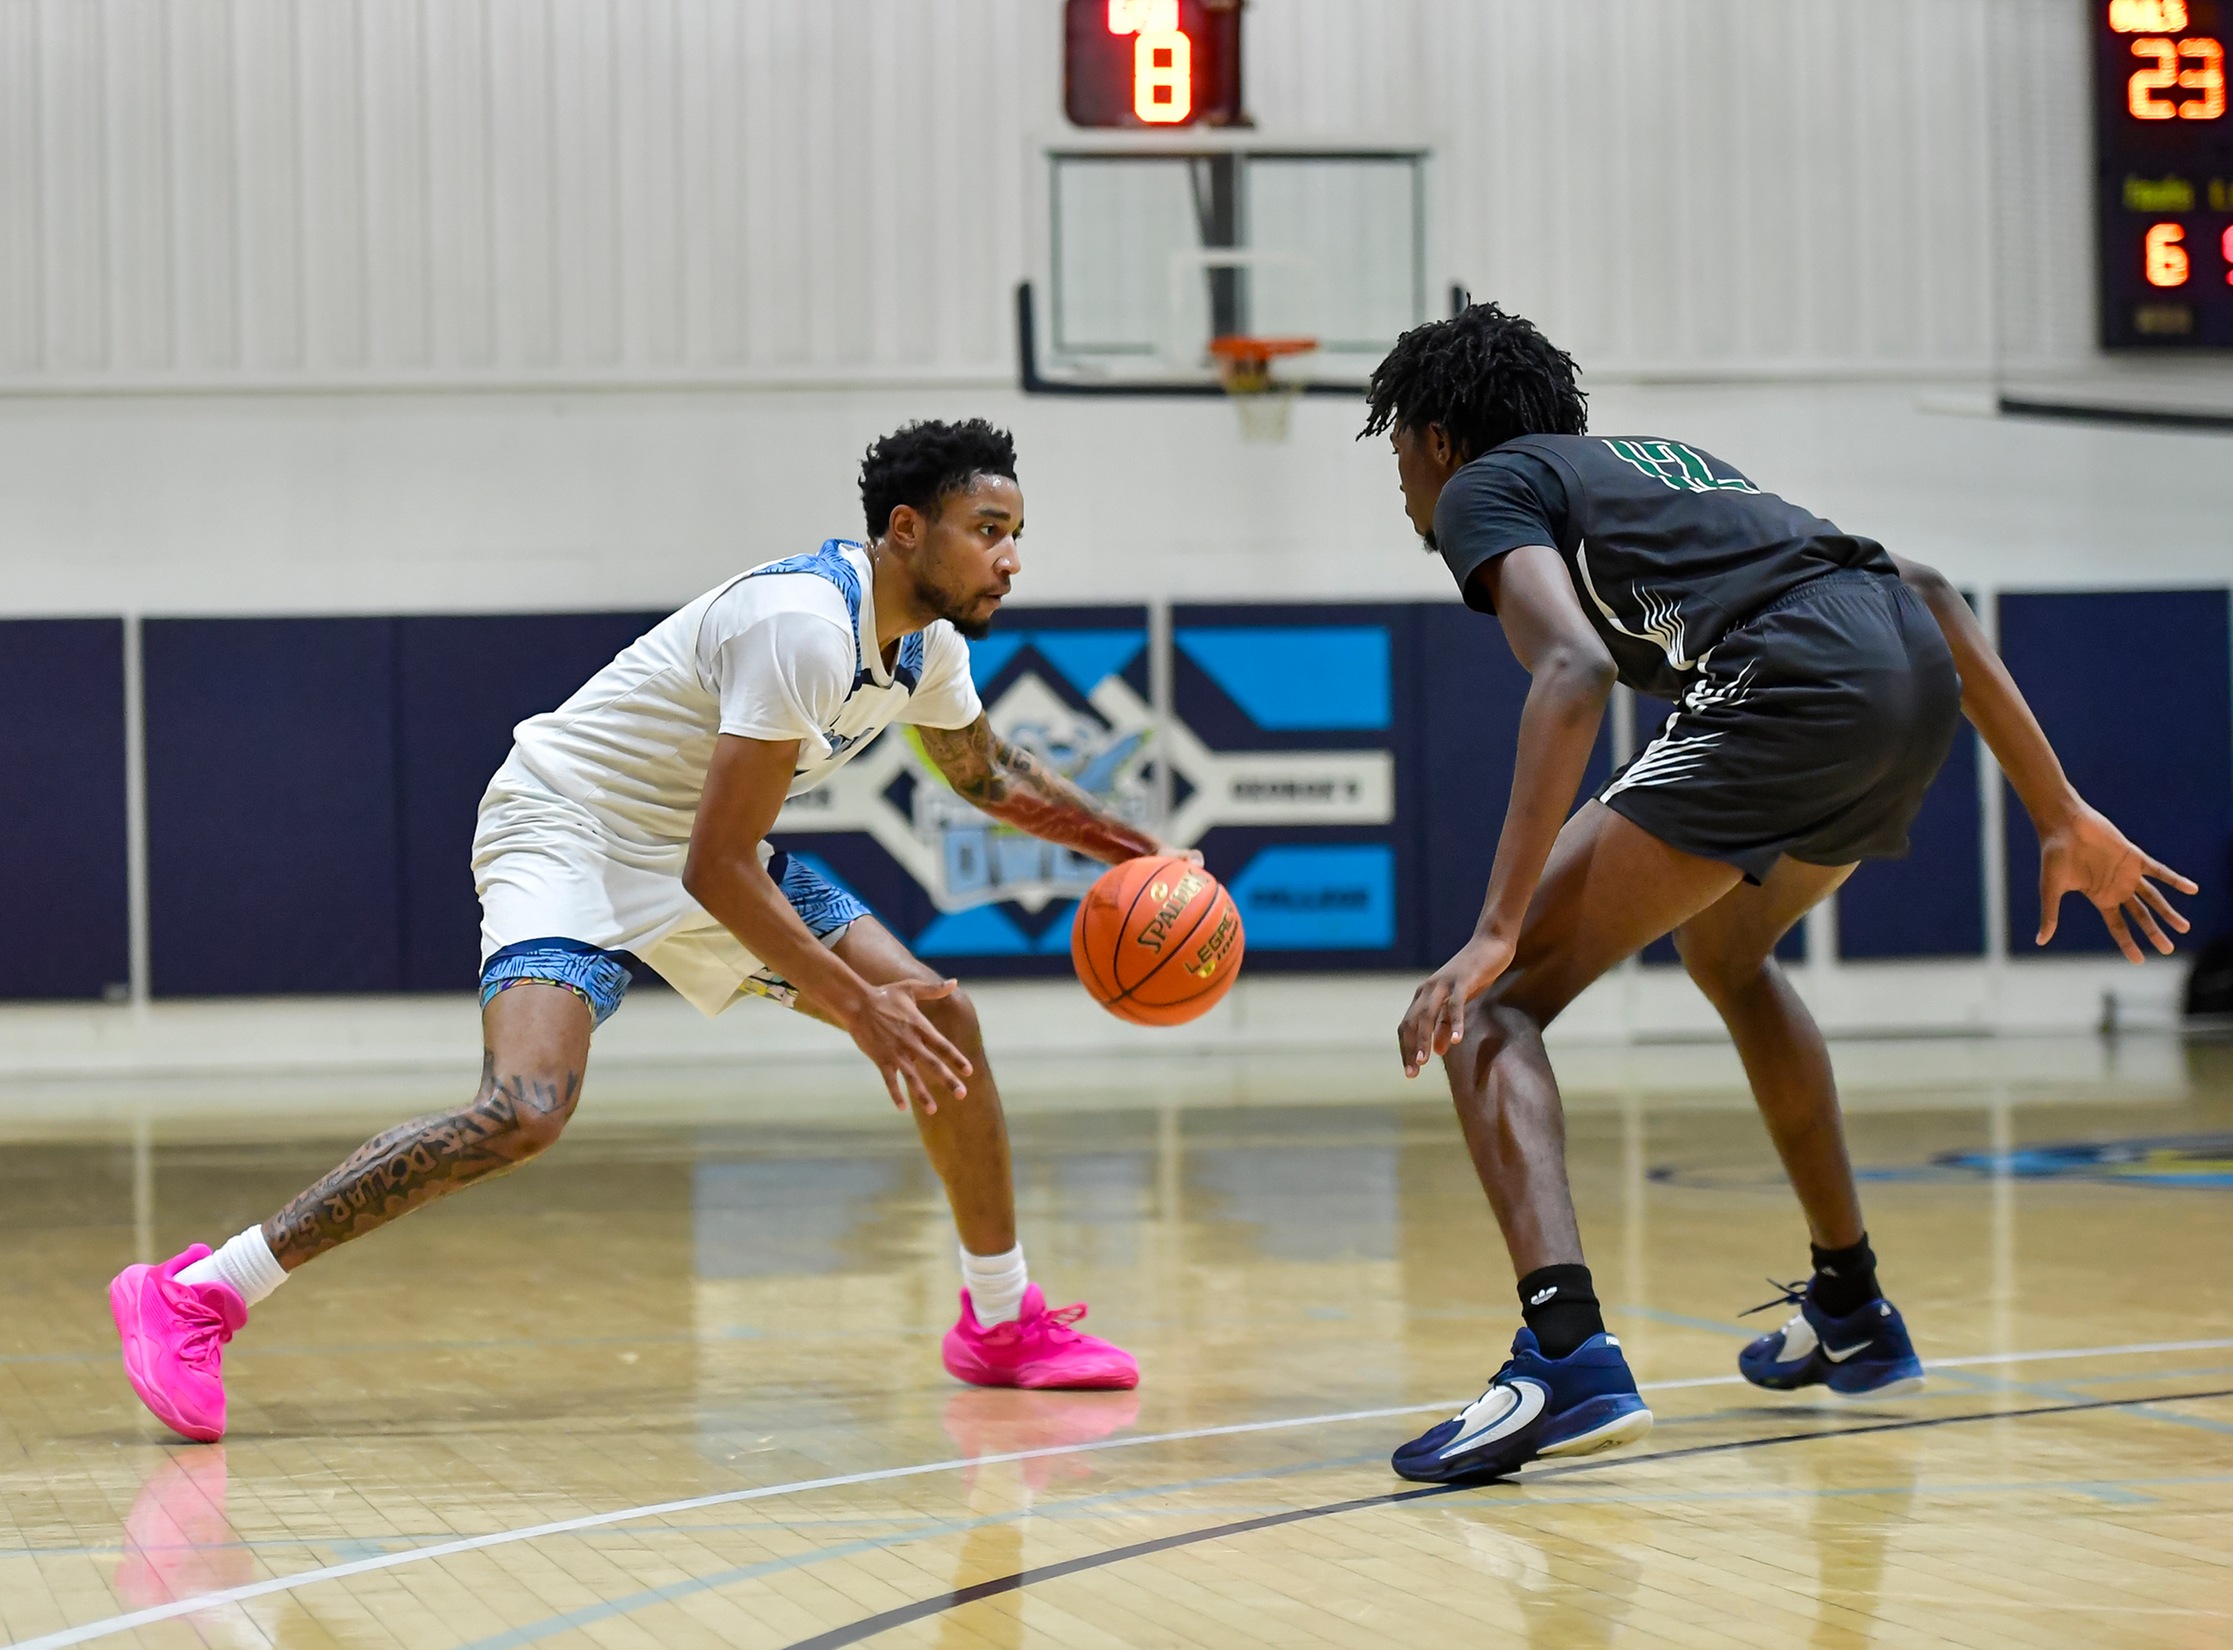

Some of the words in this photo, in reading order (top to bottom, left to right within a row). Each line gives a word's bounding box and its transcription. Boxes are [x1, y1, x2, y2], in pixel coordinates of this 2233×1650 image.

[1134, 30, 1191, 123] 8
[2128, 37, 2227, 120] 23
[2145, 223, 2189, 287] 6
